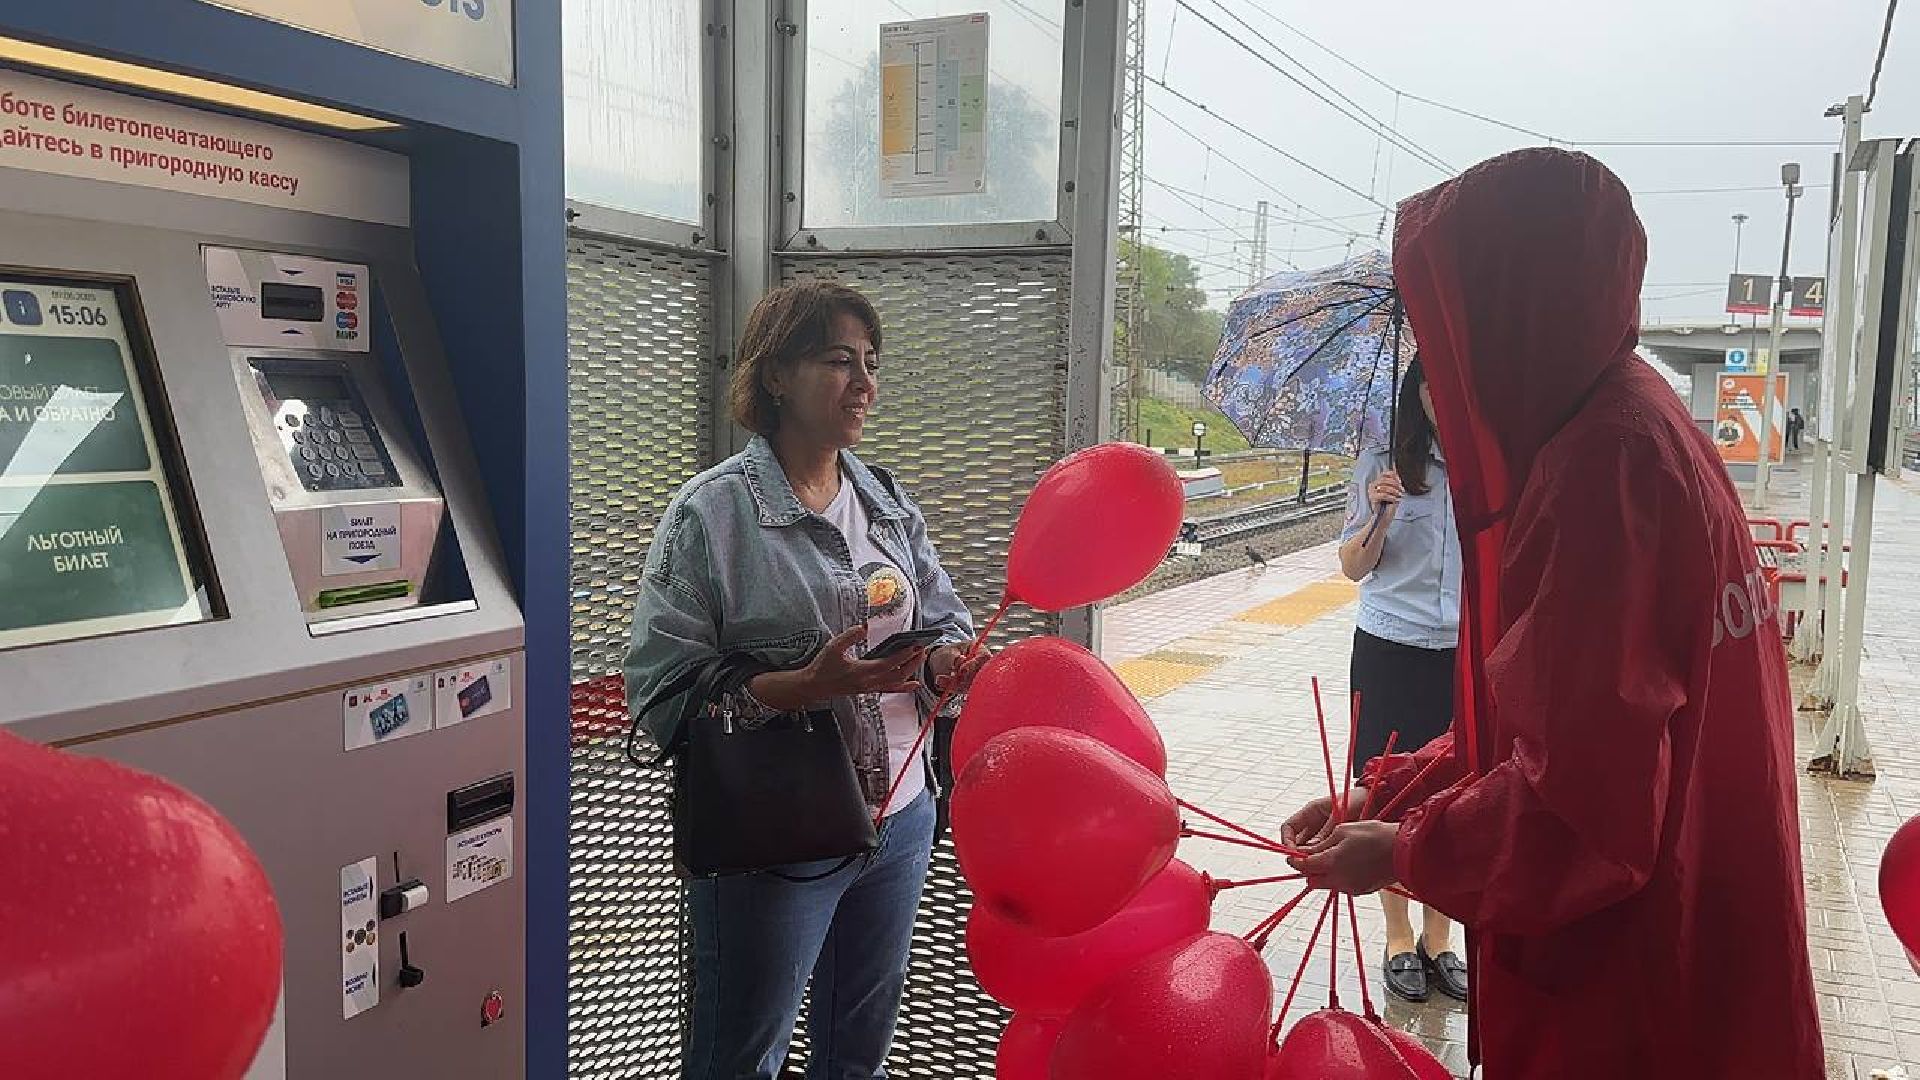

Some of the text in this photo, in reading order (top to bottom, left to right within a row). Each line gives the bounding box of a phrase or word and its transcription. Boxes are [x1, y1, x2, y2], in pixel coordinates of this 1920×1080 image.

[62, 103, 274, 160] билетопечатающего
[0, 125, 299, 196] айтесь в пригородную кассу
[1743, 278, 1755, 301] 1
[1804, 281, 1824, 304] 4
[49, 304, 108, 325] 15:06
[33, 405, 116, 422] ОБРАТНО
[27, 525, 123, 552] ЛЬГОТНЫЙ
[326, 530, 337, 541] НА
[53, 552, 109, 573] БИЛЕТ
